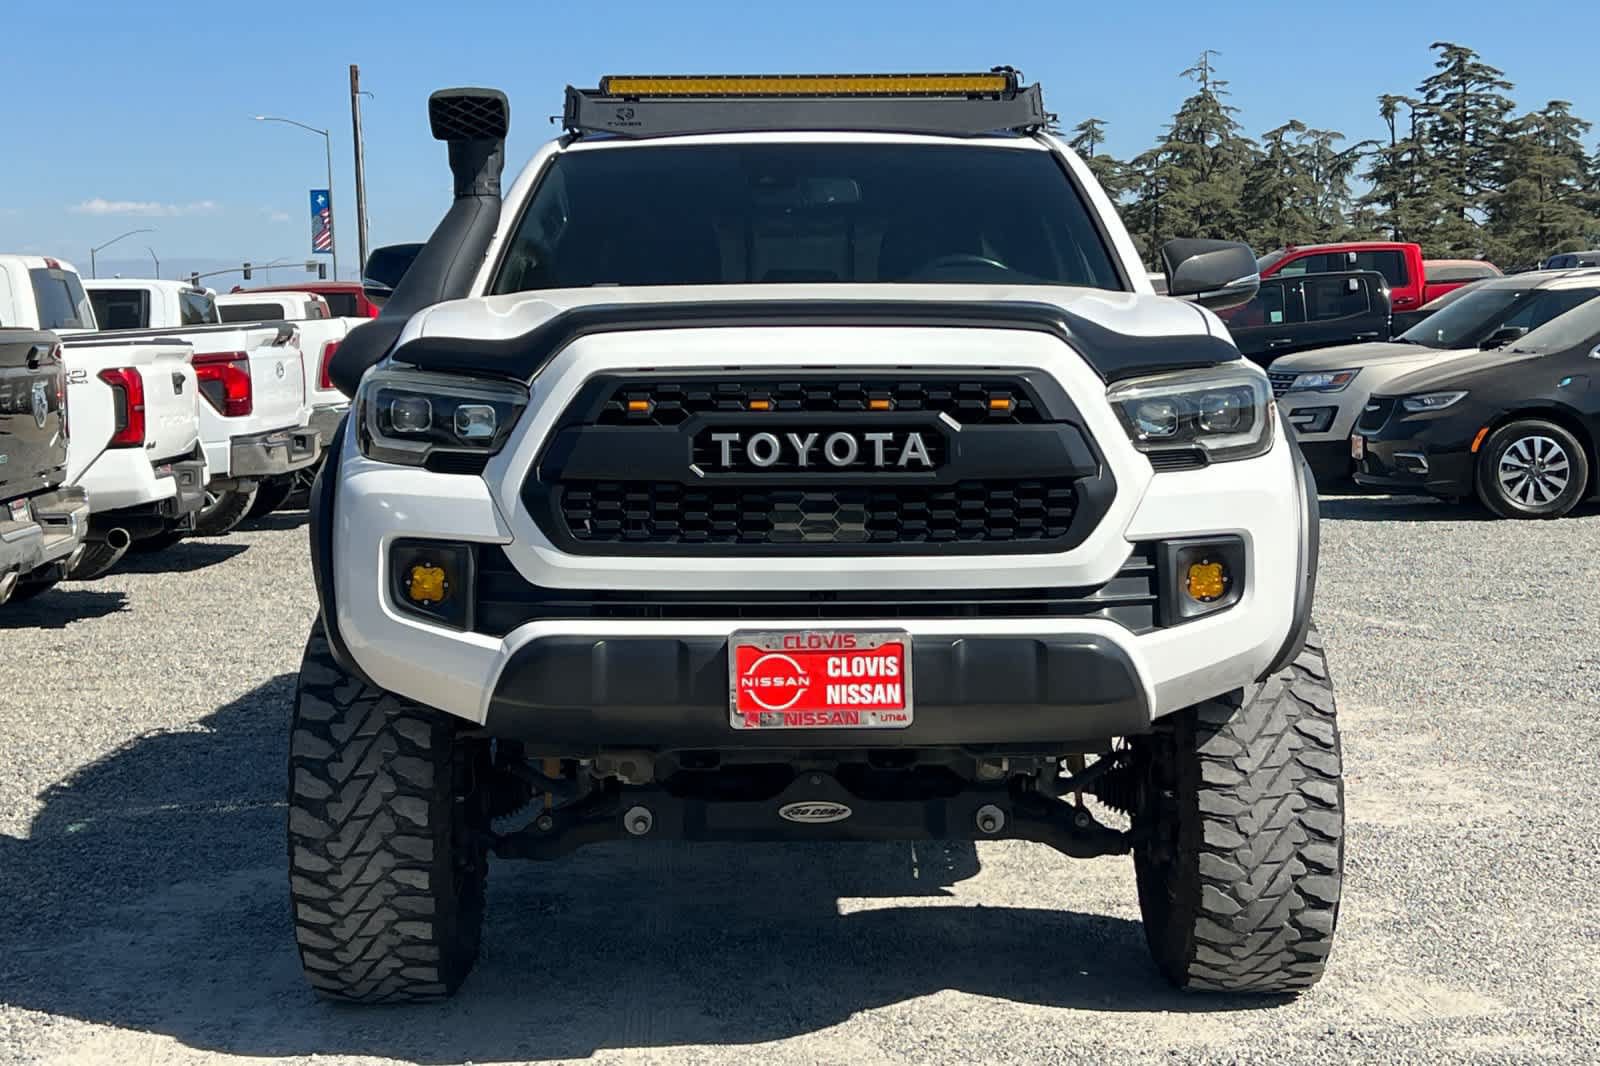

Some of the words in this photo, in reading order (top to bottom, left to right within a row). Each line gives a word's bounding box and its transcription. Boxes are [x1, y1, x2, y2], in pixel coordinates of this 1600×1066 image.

[711, 432, 932, 467] TOYOTA
[783, 634, 857, 649] CLOVIS
[827, 656, 899, 677] CLOVIS
[741, 676, 810, 687] NISSAN
[826, 684, 900, 705] NISSAN
[784, 712, 860, 726] NISSAN
